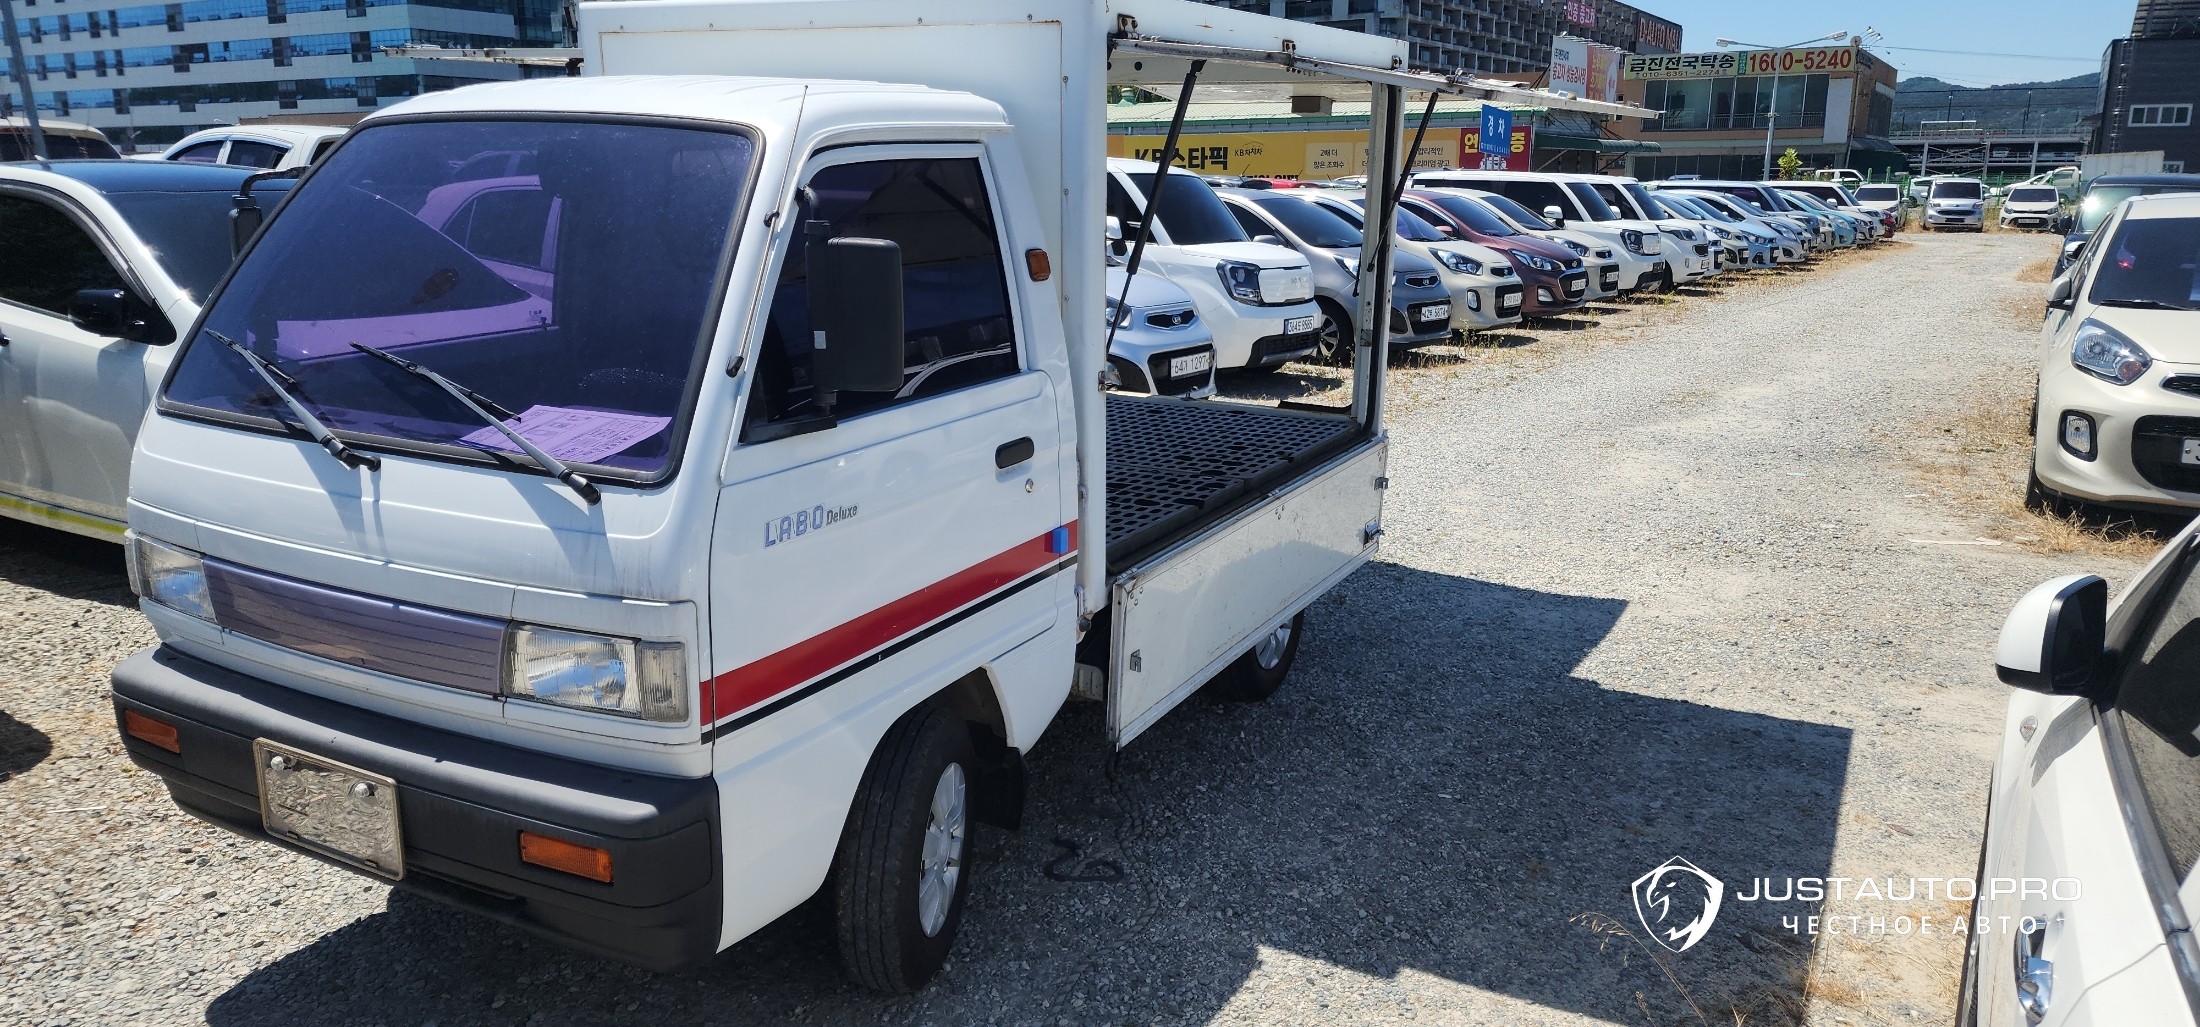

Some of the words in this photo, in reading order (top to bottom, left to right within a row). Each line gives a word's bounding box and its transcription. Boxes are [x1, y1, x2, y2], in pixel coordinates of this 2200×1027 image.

[1567, 1, 1579, 22] 인증
[1579, 4, 1596, 26] 중고차
[1630, 54, 1736, 72] 금진전국탁송
[1749, 48, 1852, 73] 1600-5240
[1331, 148, 1338, 157] 더
[1313, 161, 1326, 170] 많은
[1326, 160, 1345, 169] 조회수
[764, 505, 824, 548] LABO
[826, 504, 858, 526] Deluxe
